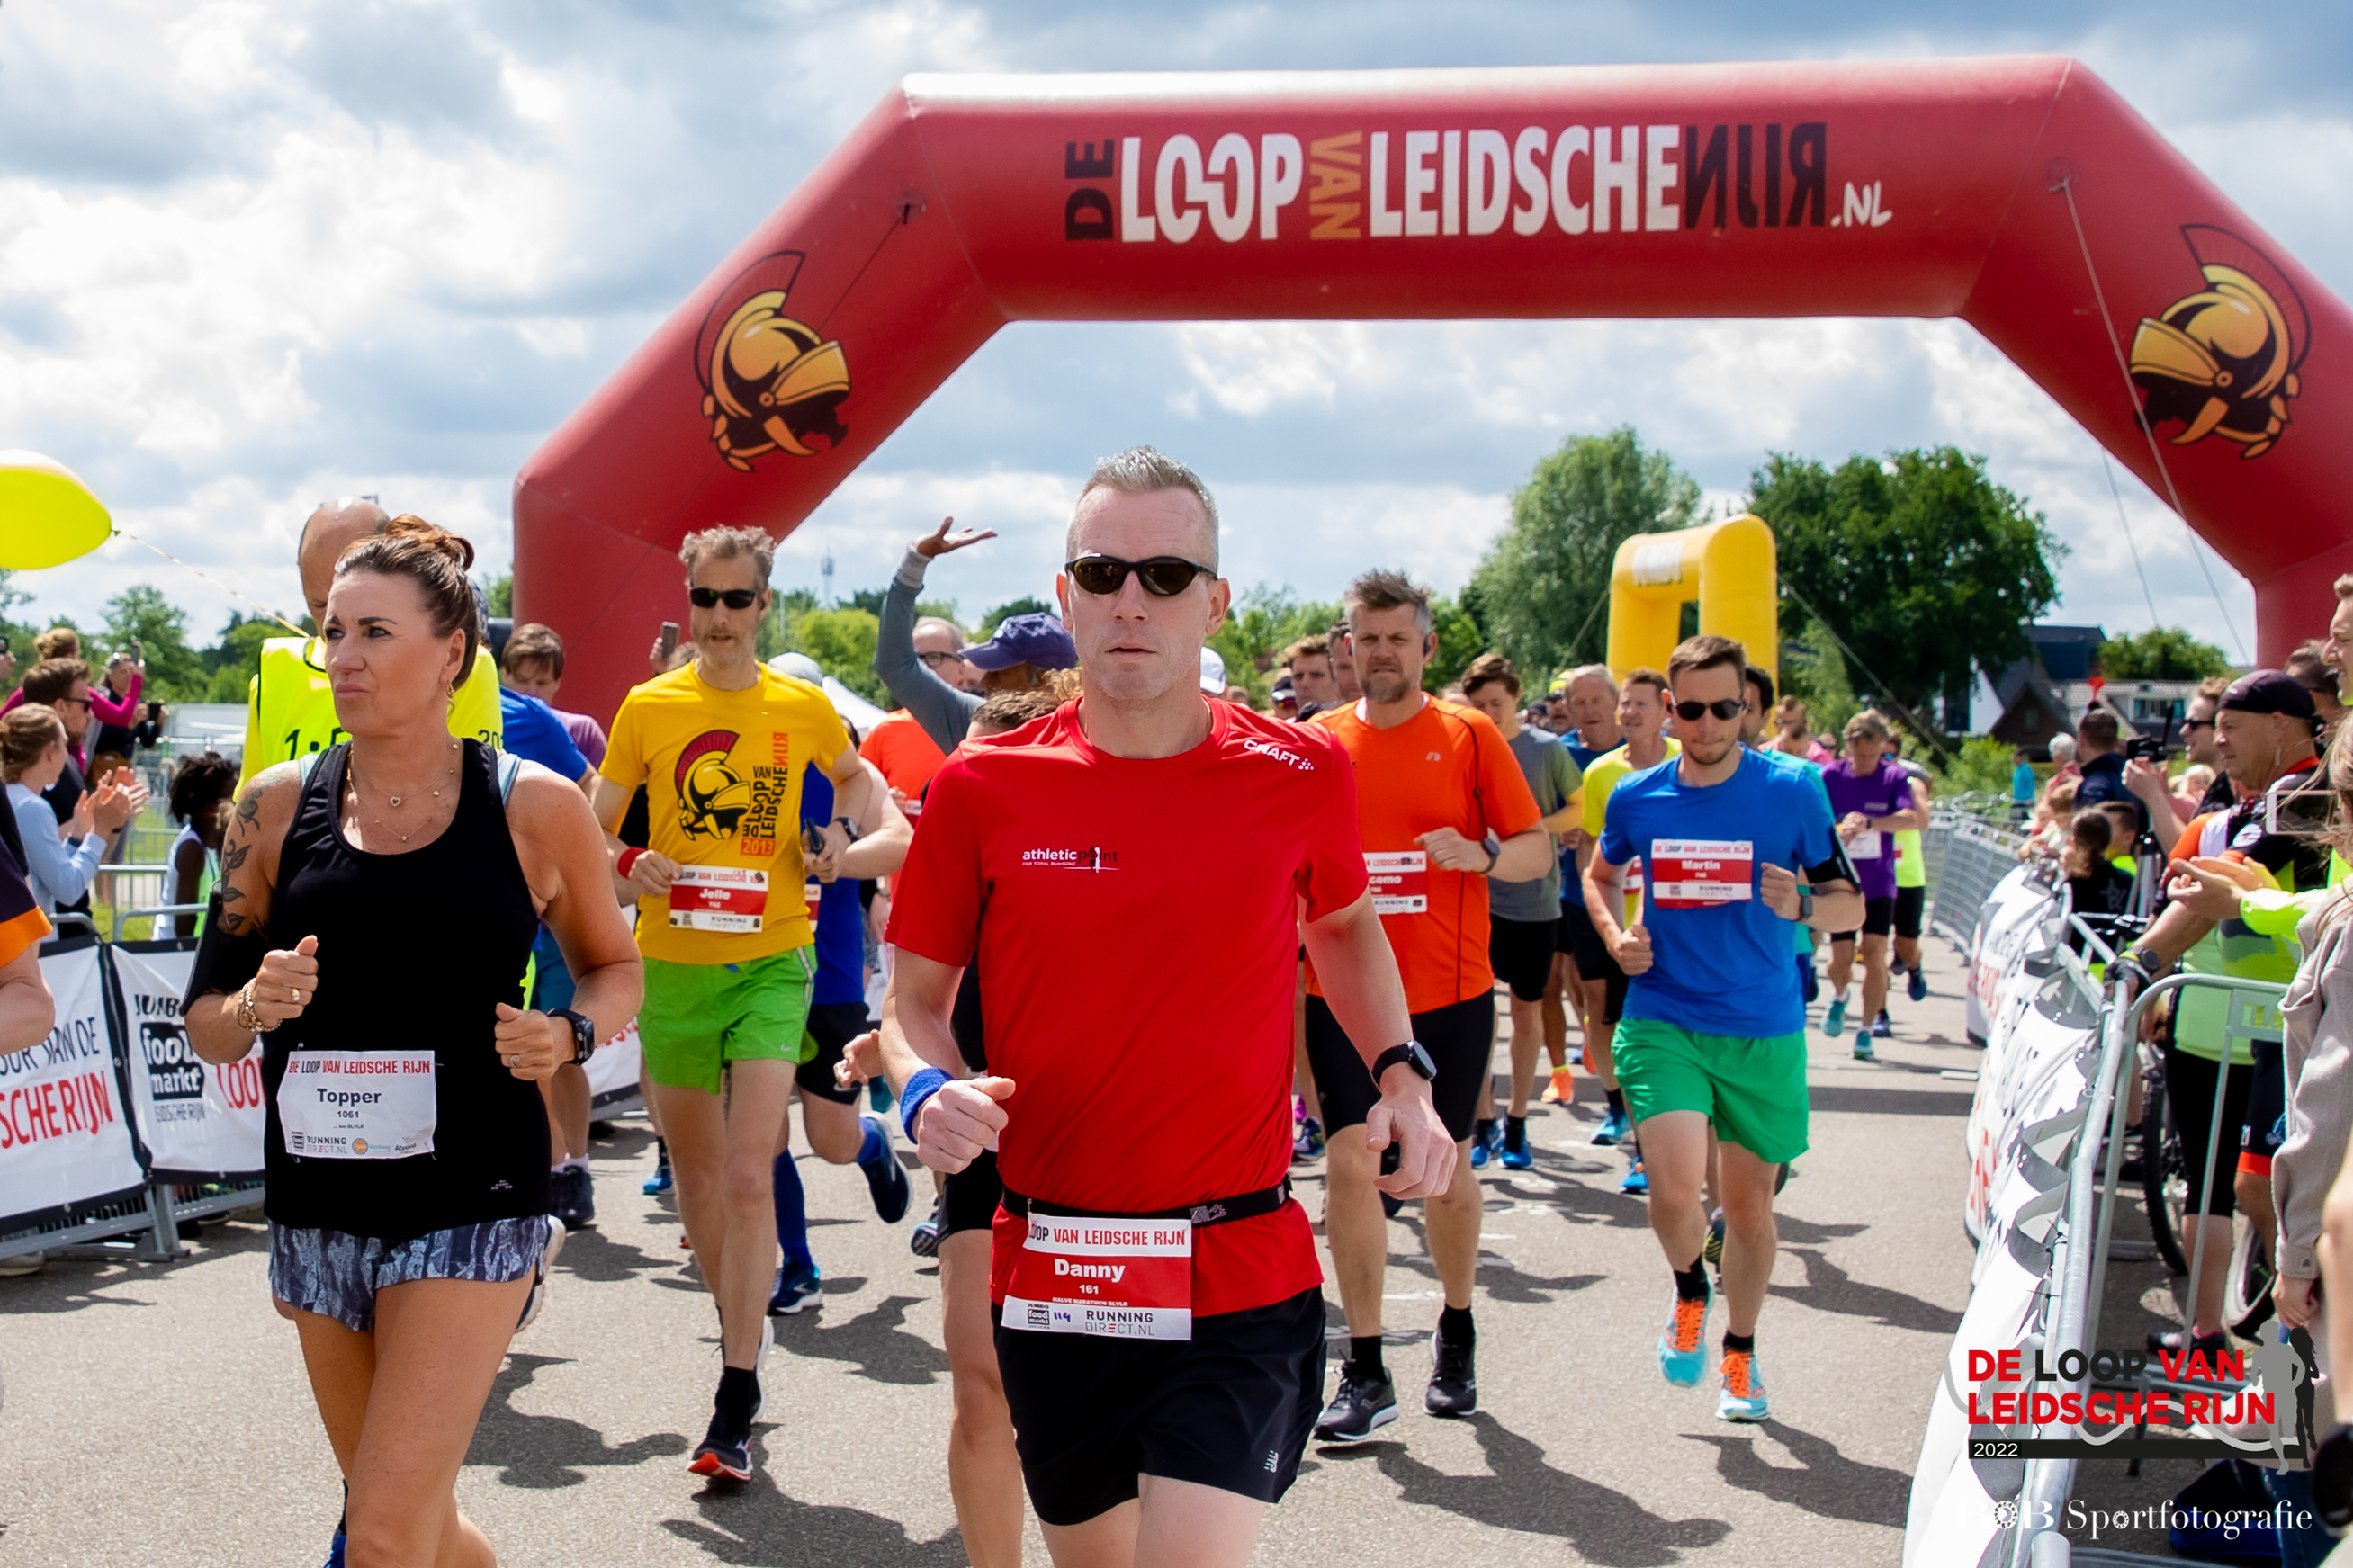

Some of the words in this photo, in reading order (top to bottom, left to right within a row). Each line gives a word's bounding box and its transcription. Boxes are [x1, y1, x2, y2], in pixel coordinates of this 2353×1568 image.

[1064, 139, 1115, 241] DE
[1120, 132, 1304, 244] LOOP
[1308, 131, 1363, 241] VAN
[1369, 125, 1680, 238] LEIDSCHE
[1829, 179, 1893, 228] .NL
[1243, 739, 1301, 766] CRAFT
[741, 838, 774, 856] 2013
[1022, 847, 1078, 861] athletic
[1681, 859, 1720, 871] Martin
[699, 888, 731, 900] Jelle
[75, 1016, 100, 1058] DE
[288, 1061, 301, 1074] DE
[301, 1061, 320, 1073] LOOP
[322, 1061, 341, 1074] VAN
[344, 1061, 399, 1074] LEIDSCHE
[402, 1060, 431, 1074] RIJN
[150, 1066, 202, 1094] markt
[216, 1056, 267, 1109] LOO
[317, 1088, 382, 1107] Topper
[337, 1110, 360, 1119] 1061
[307, 1135, 347, 1145] RUNNING
[1054, 1228, 1079, 1244] VAN
[1085, 1230, 1148, 1245] LEIDSCHE
[1154, 1231, 1185, 1245] RIJN
[1054, 1258, 1125, 1283] Danny
[1079, 1284, 1099, 1295] 161
[1028, 1309, 1048, 1319] food
[1086, 1310, 1154, 1323] RUNNING
[1085, 1322, 1155, 1337] DIRECT.NL
